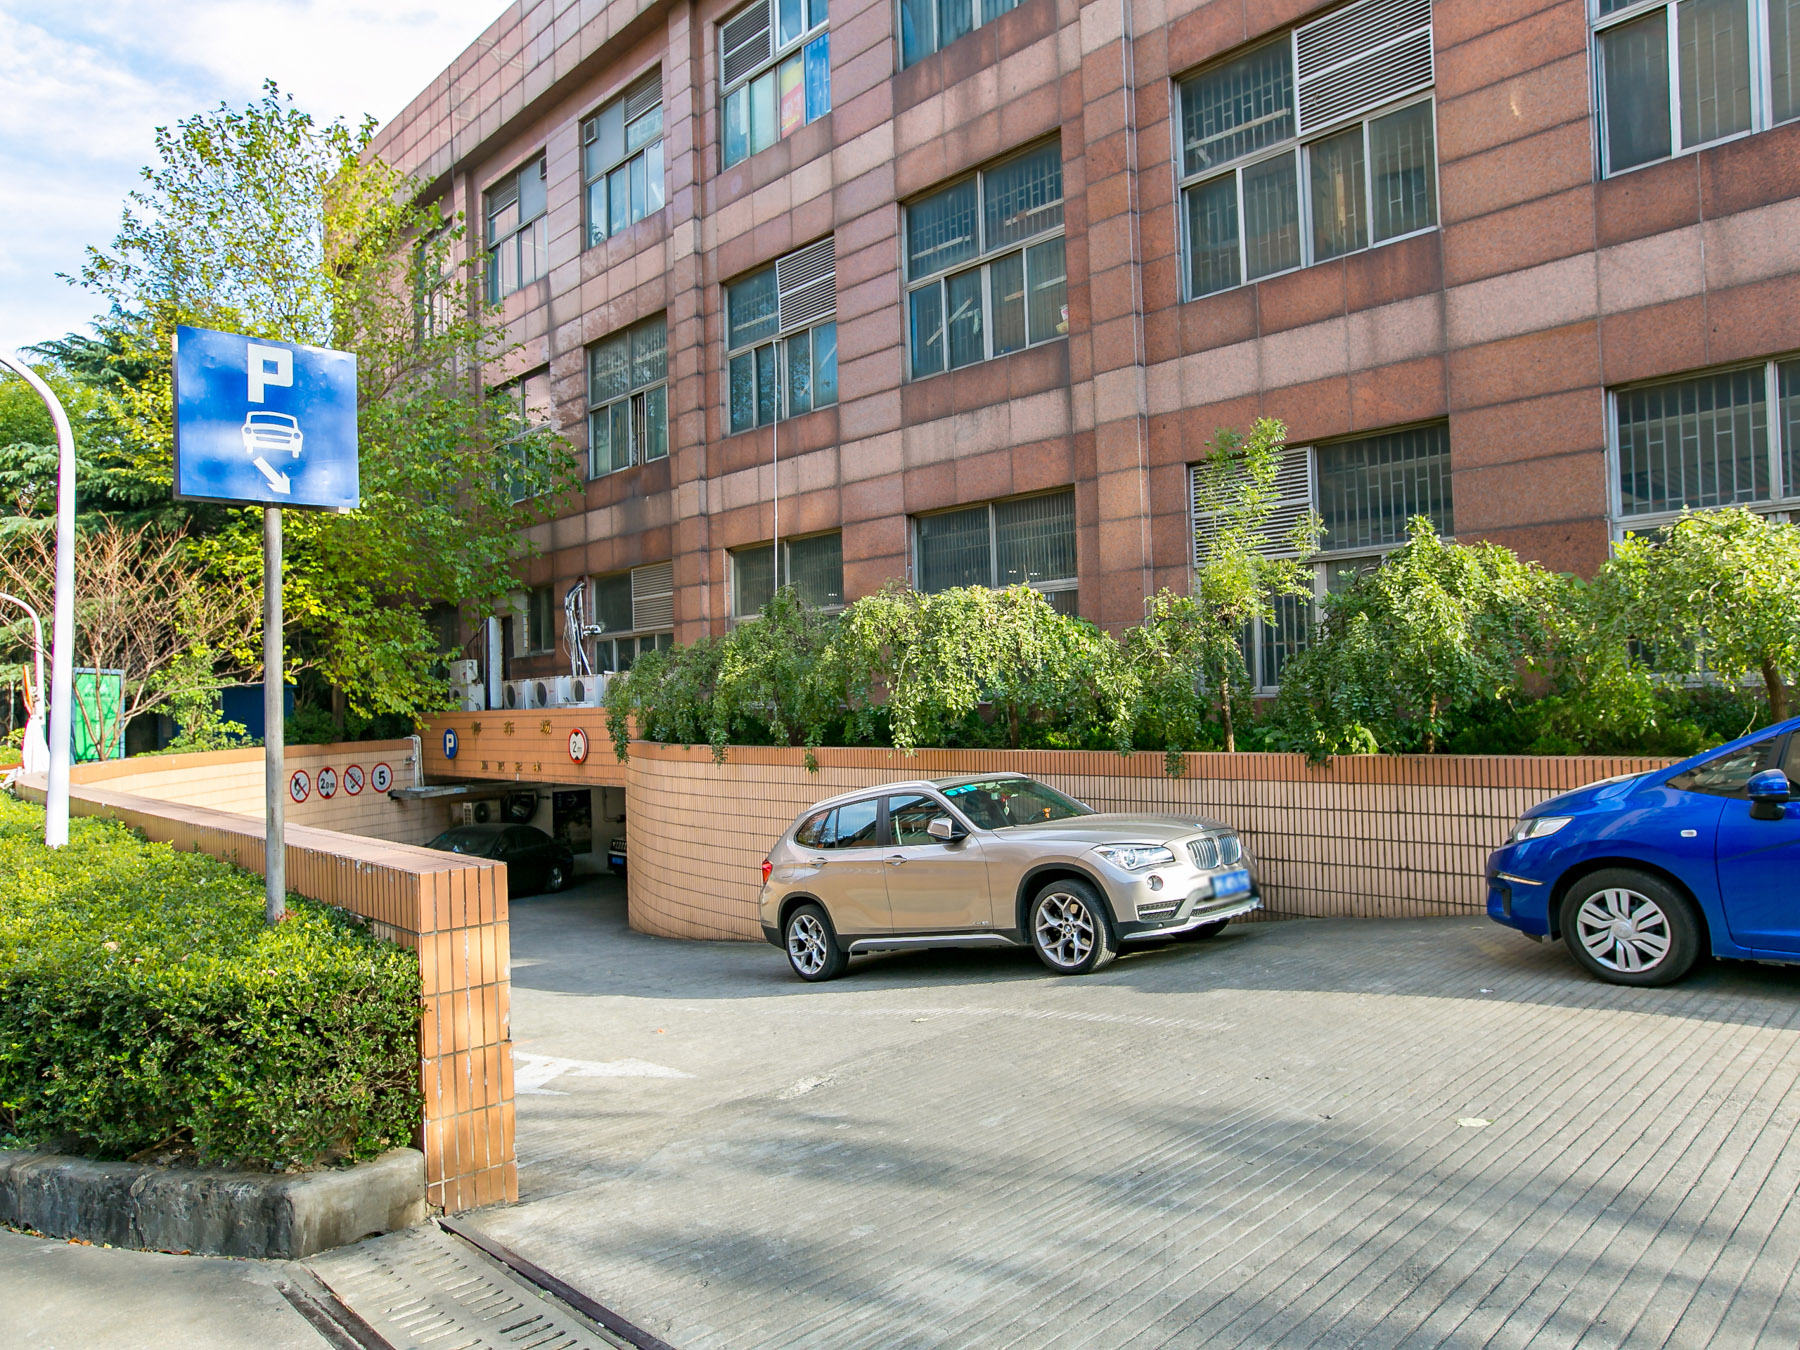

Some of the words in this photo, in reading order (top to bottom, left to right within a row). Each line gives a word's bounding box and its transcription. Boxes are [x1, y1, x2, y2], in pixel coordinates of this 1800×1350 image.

[247, 343, 293, 404] P
[446, 734, 454, 755] P
[378, 771, 386, 785] 5
